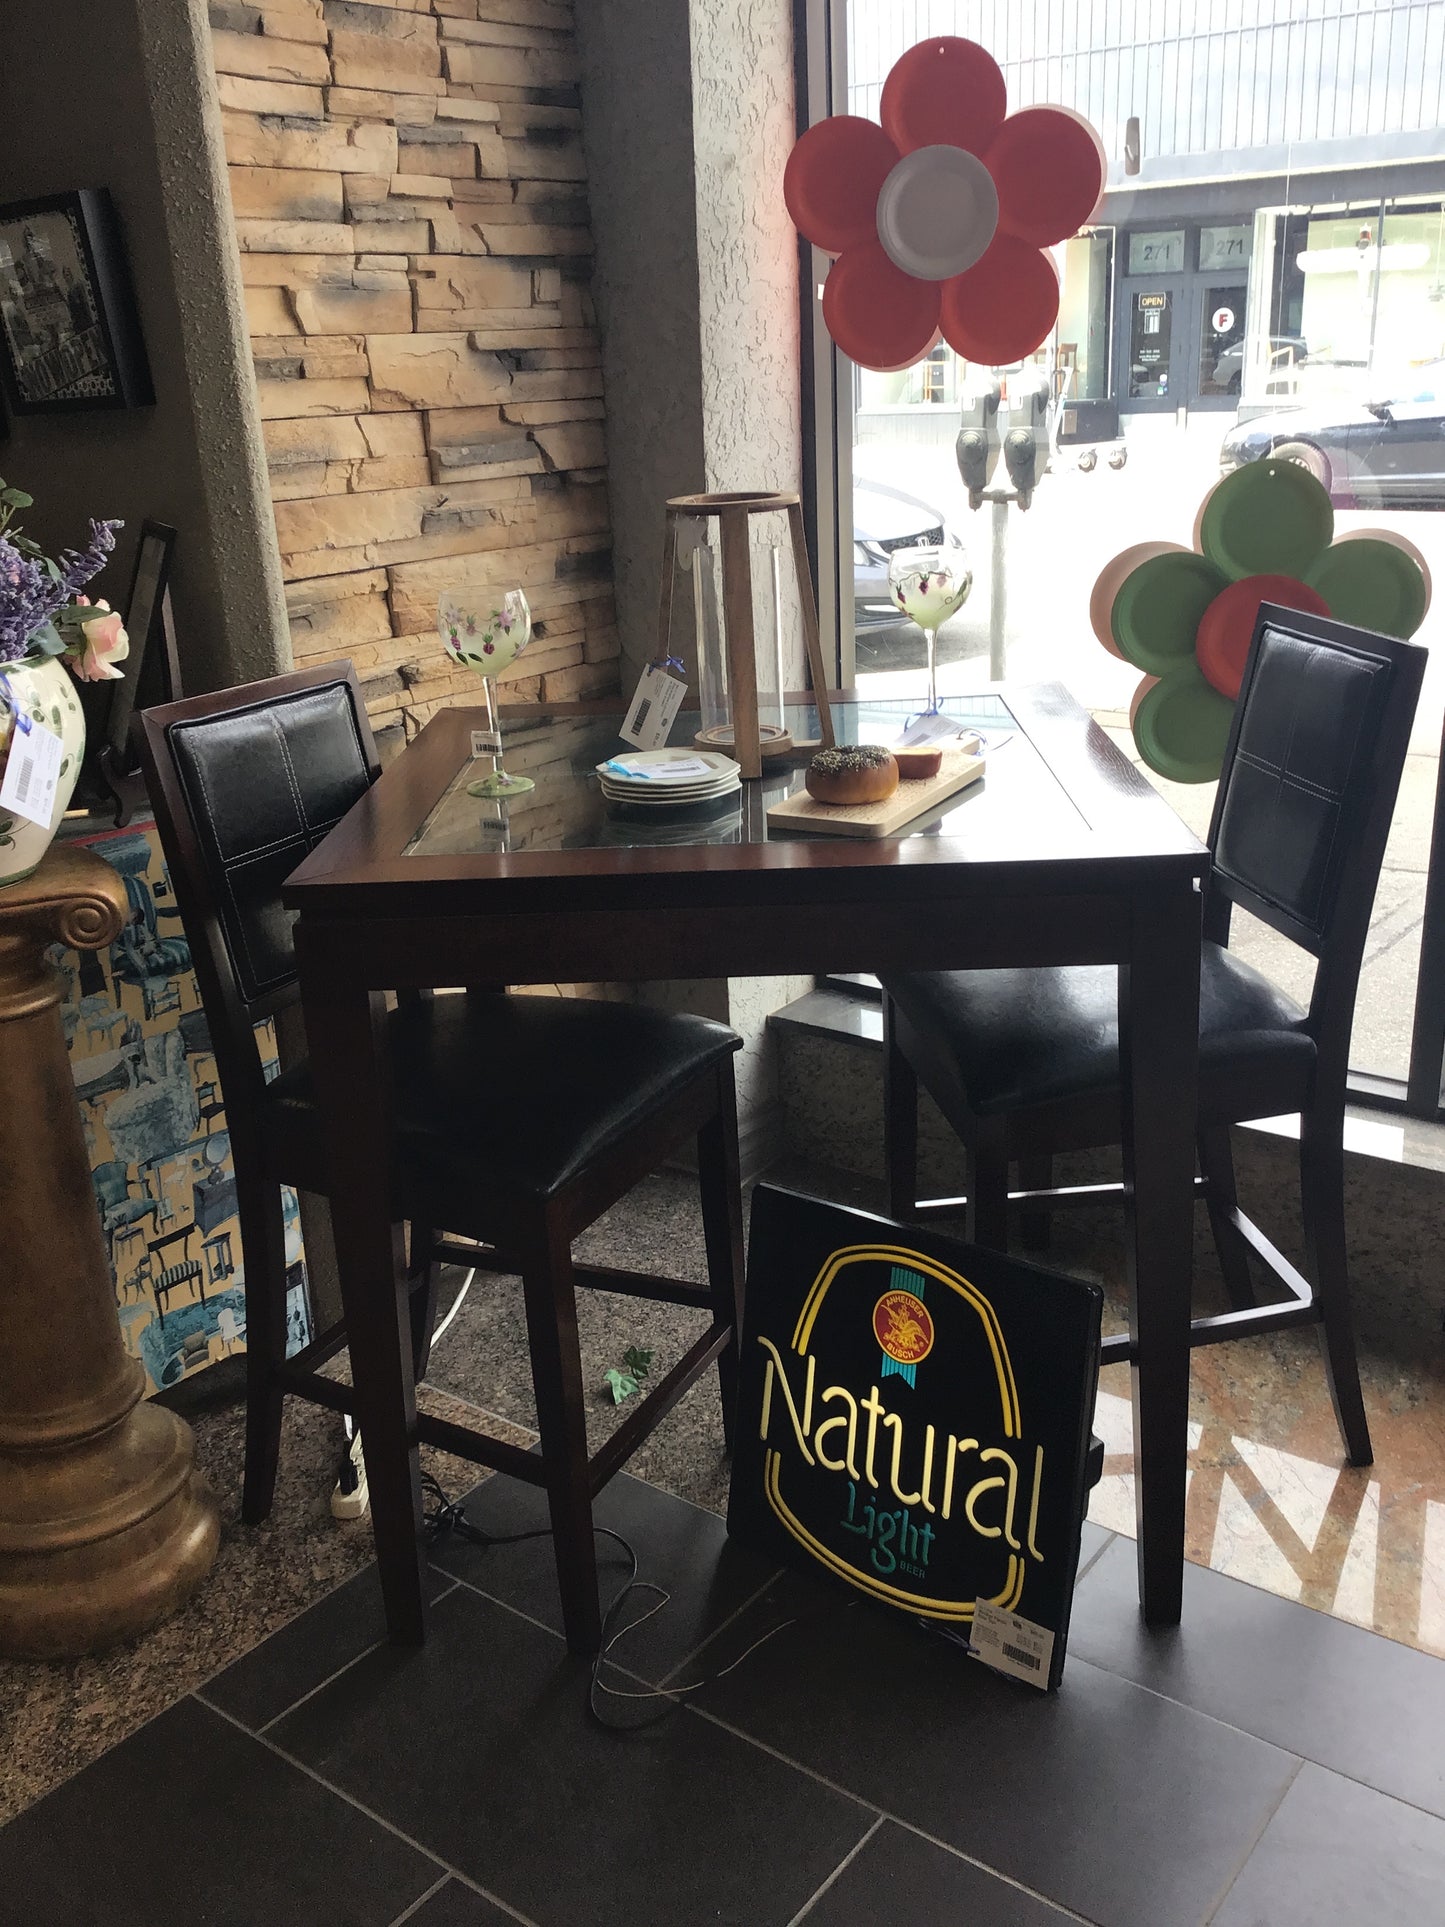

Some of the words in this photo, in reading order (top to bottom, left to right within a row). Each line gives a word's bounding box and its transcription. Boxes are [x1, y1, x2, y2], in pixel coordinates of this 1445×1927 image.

[1143, 244, 1170, 261] 271
[1216, 239, 1243, 256] 271
[1141, 296, 1163, 306] OPEN
[1218, 313, 1228, 328] F
[886, 1295, 924, 1318] ANHEUSER
[886, 1342, 915, 1359] BUSCH
[758, 1336, 1044, 1562] Natural
[840, 1481, 936, 1574] Light
[899, 1560, 926, 1579] BEER
